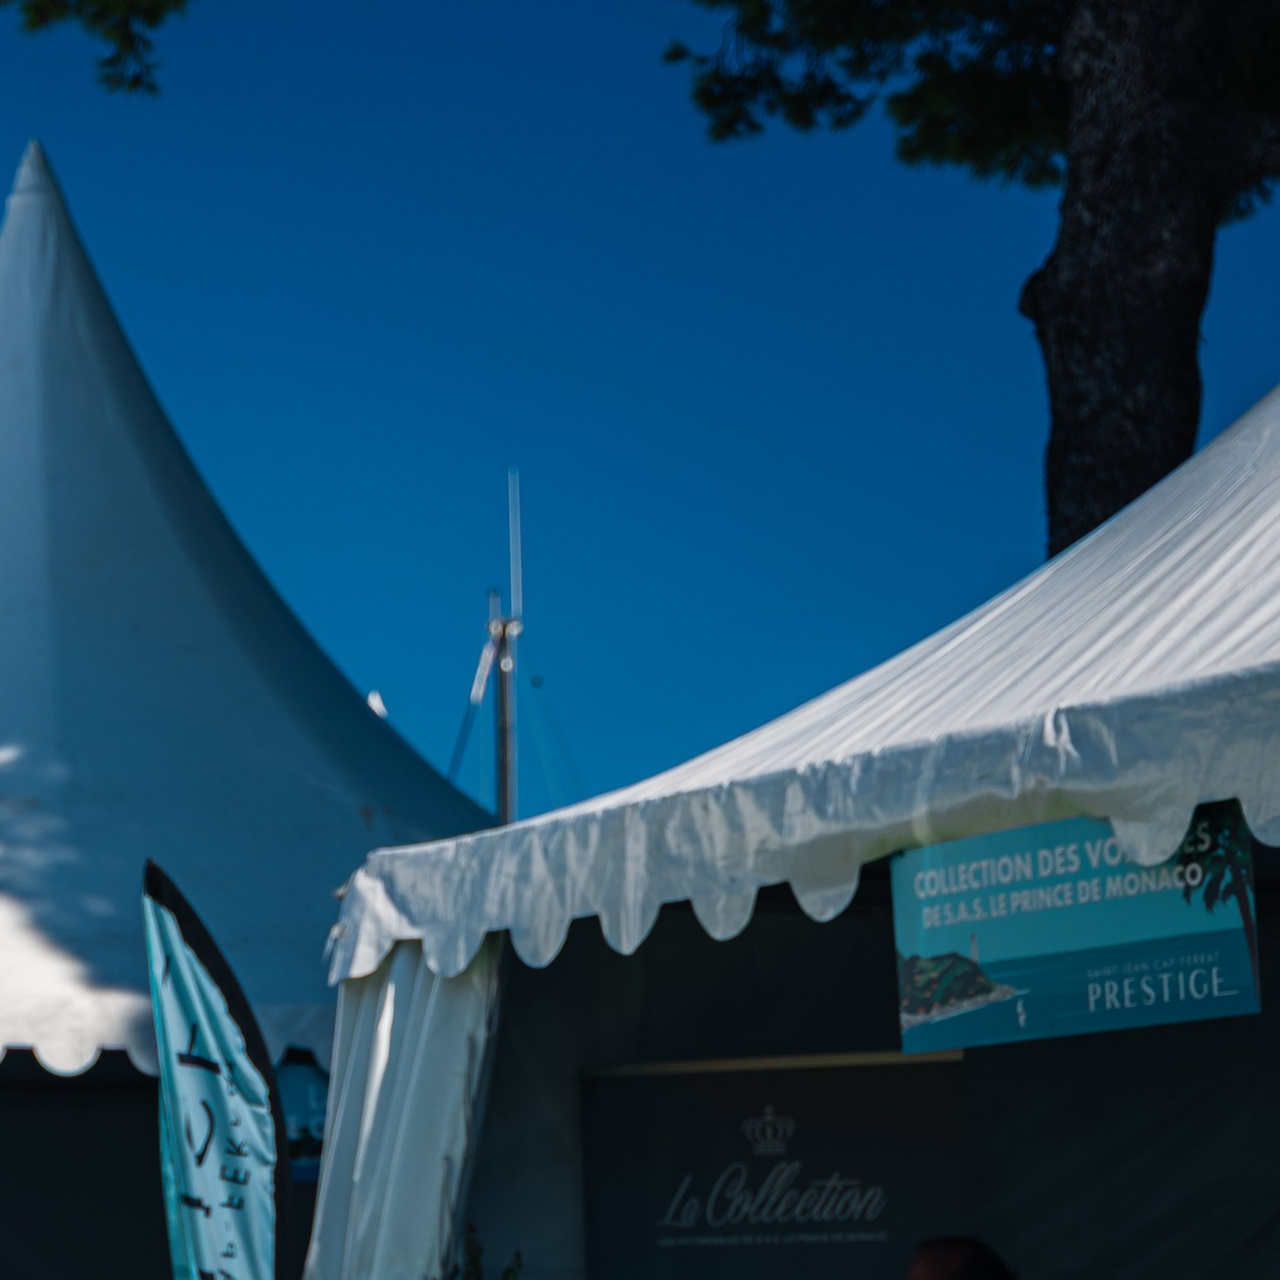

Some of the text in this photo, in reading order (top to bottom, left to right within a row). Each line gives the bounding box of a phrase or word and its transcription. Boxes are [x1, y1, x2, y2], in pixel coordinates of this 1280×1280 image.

[914, 852, 1033, 899] COLLECTION
[1038, 844, 1080, 878] DES
[923, 904, 941, 929] DE
[989, 893, 1007, 918] LE
[1010, 882, 1073, 914] PRINCE
[1078, 877, 1102, 904] DE
[1106, 862, 1203, 897] MONACO
[1087, 966, 1239, 1013] PRESTIGE
[705, 1159, 888, 1228] Collection
